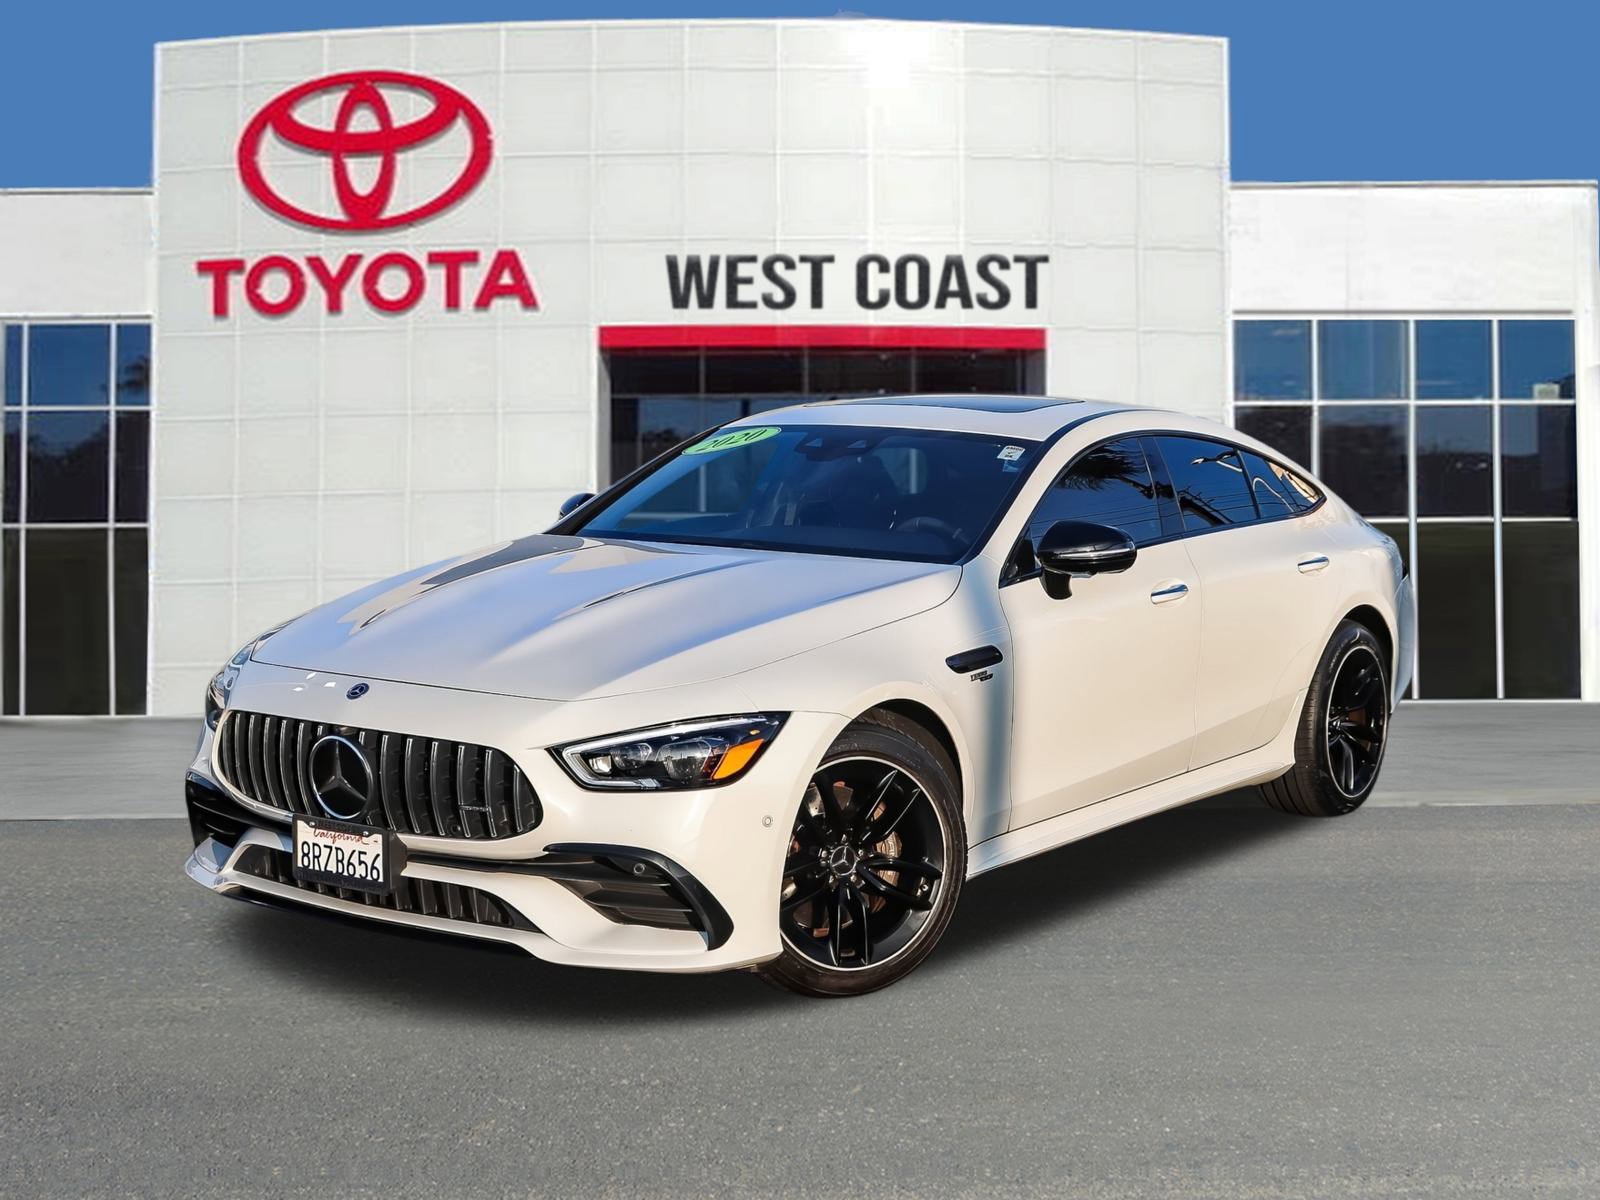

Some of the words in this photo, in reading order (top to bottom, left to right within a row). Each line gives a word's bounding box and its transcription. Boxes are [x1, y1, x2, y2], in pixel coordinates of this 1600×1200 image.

[197, 249, 537, 316] TOYOTA
[667, 254, 834, 309] WEST
[857, 254, 1049, 309] COAST
[694, 428, 768, 452] 2020
[301, 841, 381, 881] 8RZB656
